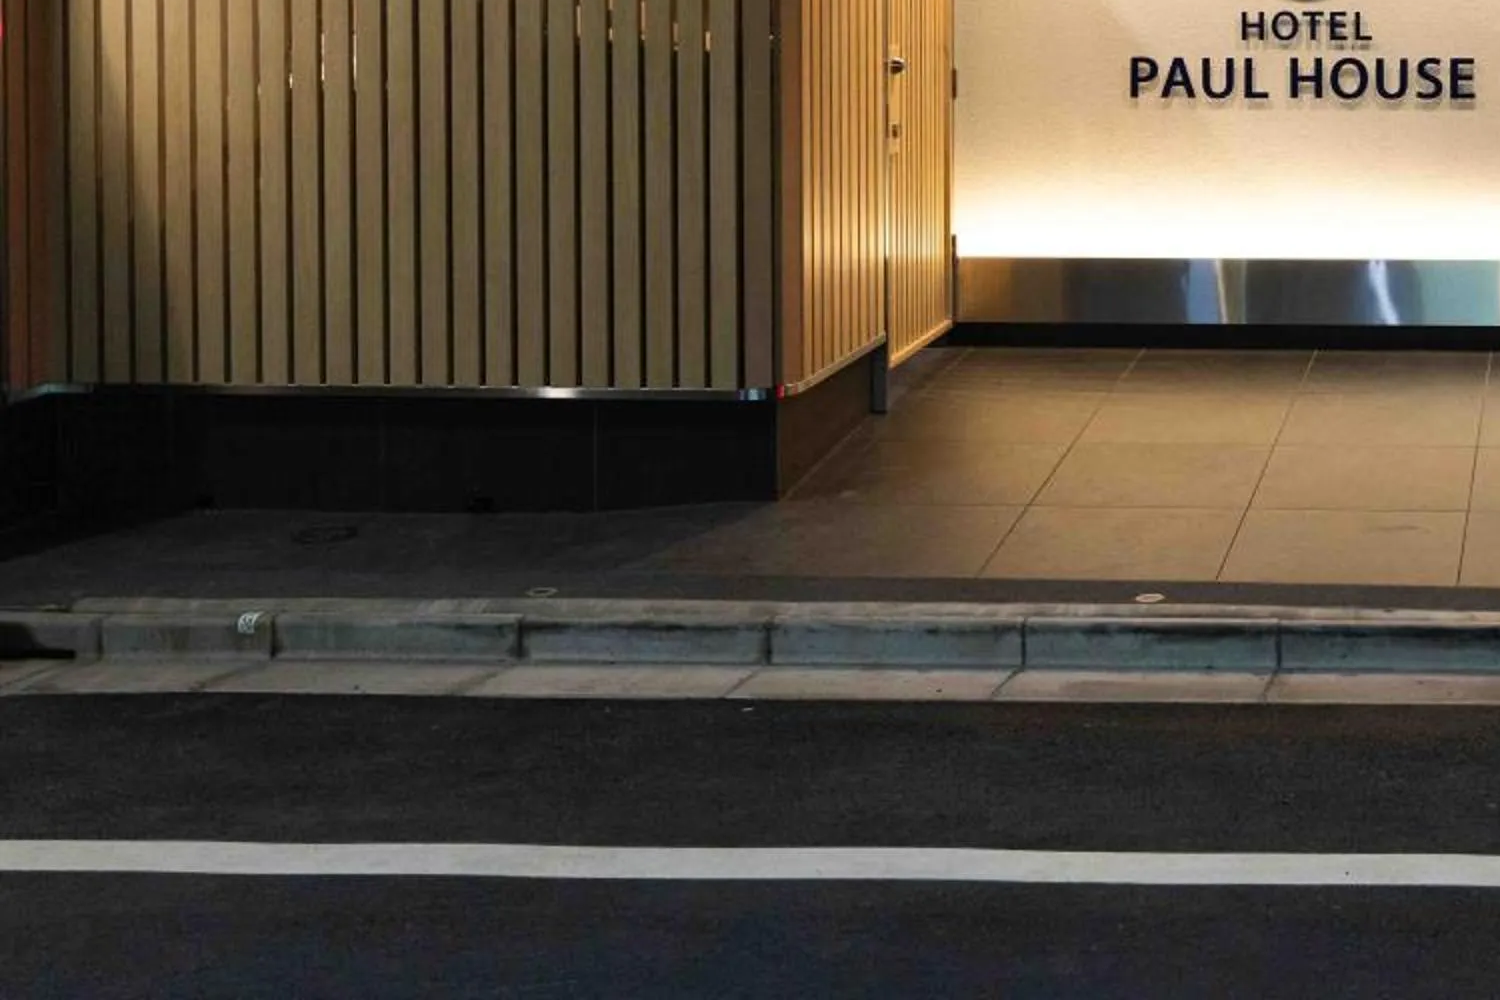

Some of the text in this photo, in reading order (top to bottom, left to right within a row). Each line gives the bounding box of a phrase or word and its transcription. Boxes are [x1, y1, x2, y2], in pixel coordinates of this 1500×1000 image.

[1241, 11, 1373, 41] HOTEL
[1130, 57, 1475, 100] PAUL HOUSE
